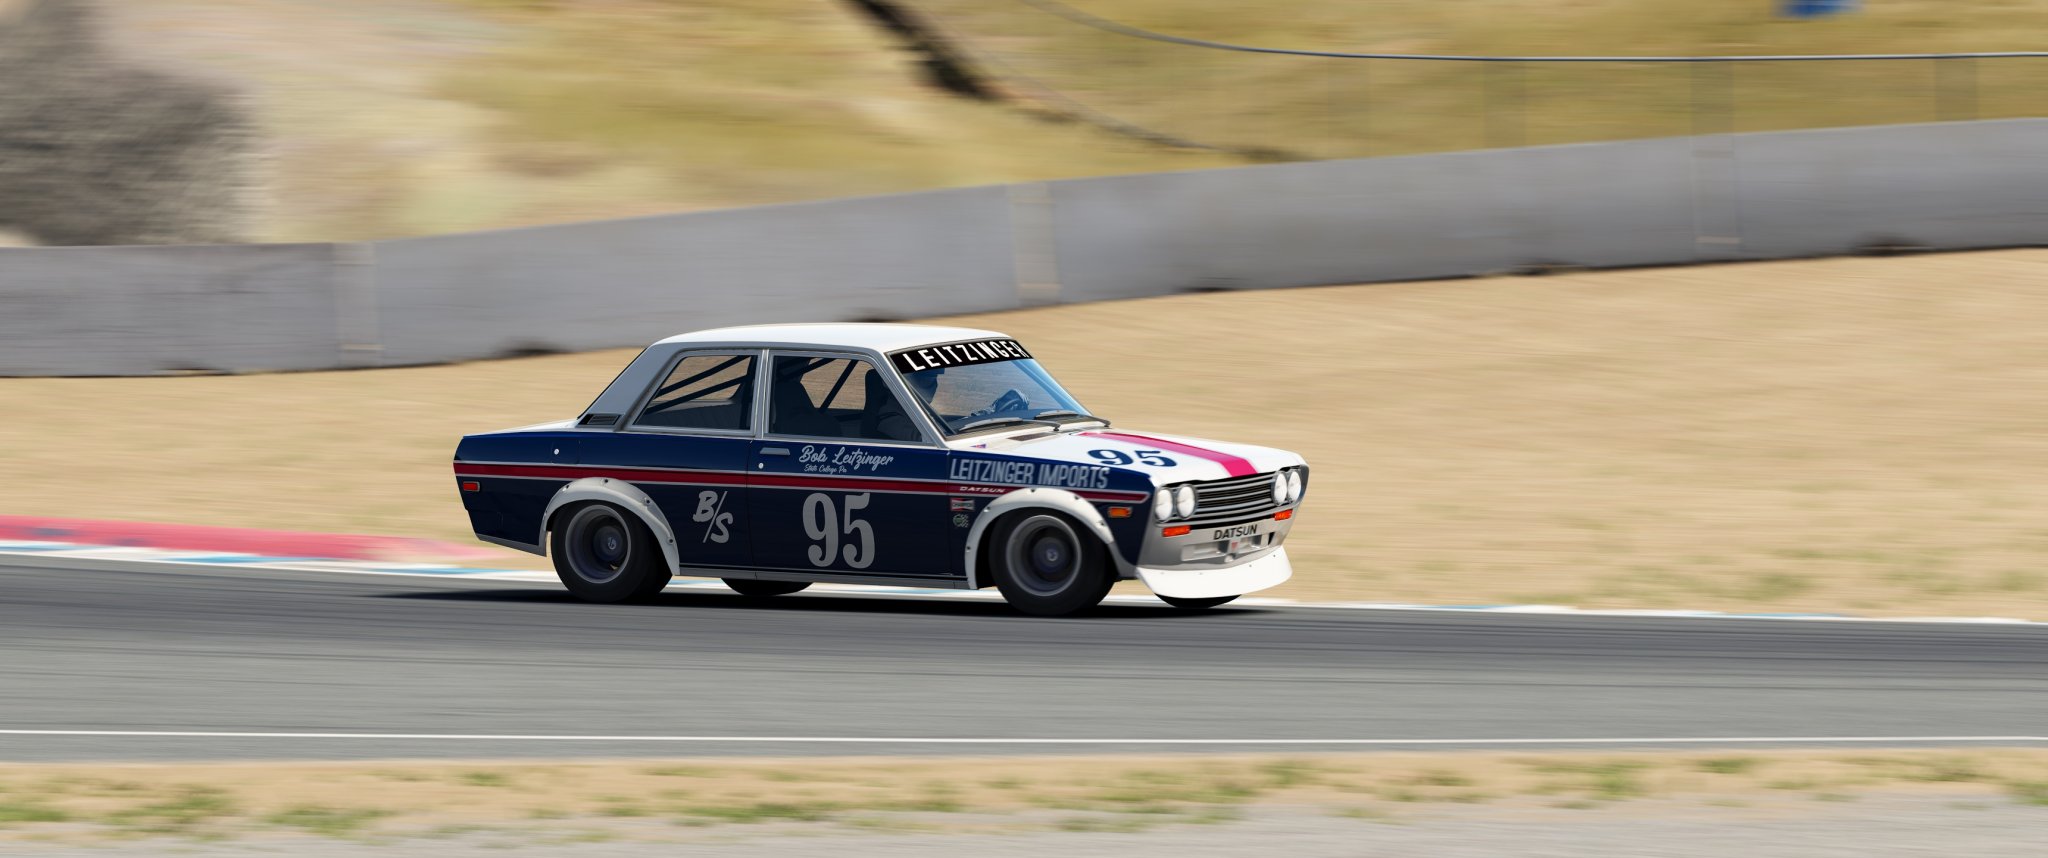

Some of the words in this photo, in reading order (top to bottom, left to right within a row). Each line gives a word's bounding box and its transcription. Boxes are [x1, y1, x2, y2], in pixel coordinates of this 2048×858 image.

[902, 340, 1030, 371] LEITZINGER
[799, 445, 828, 463] Bob
[832, 446, 894, 471] Leitzinger
[950, 458, 1034, 484] LEITZINGER
[1038, 464, 1110, 489] IMPORTS
[1087, 449, 1177, 467] 95
[693, 490, 733, 543] B/S
[802, 492, 875, 569] 95
[1213, 524, 1258, 540] DATSUN
